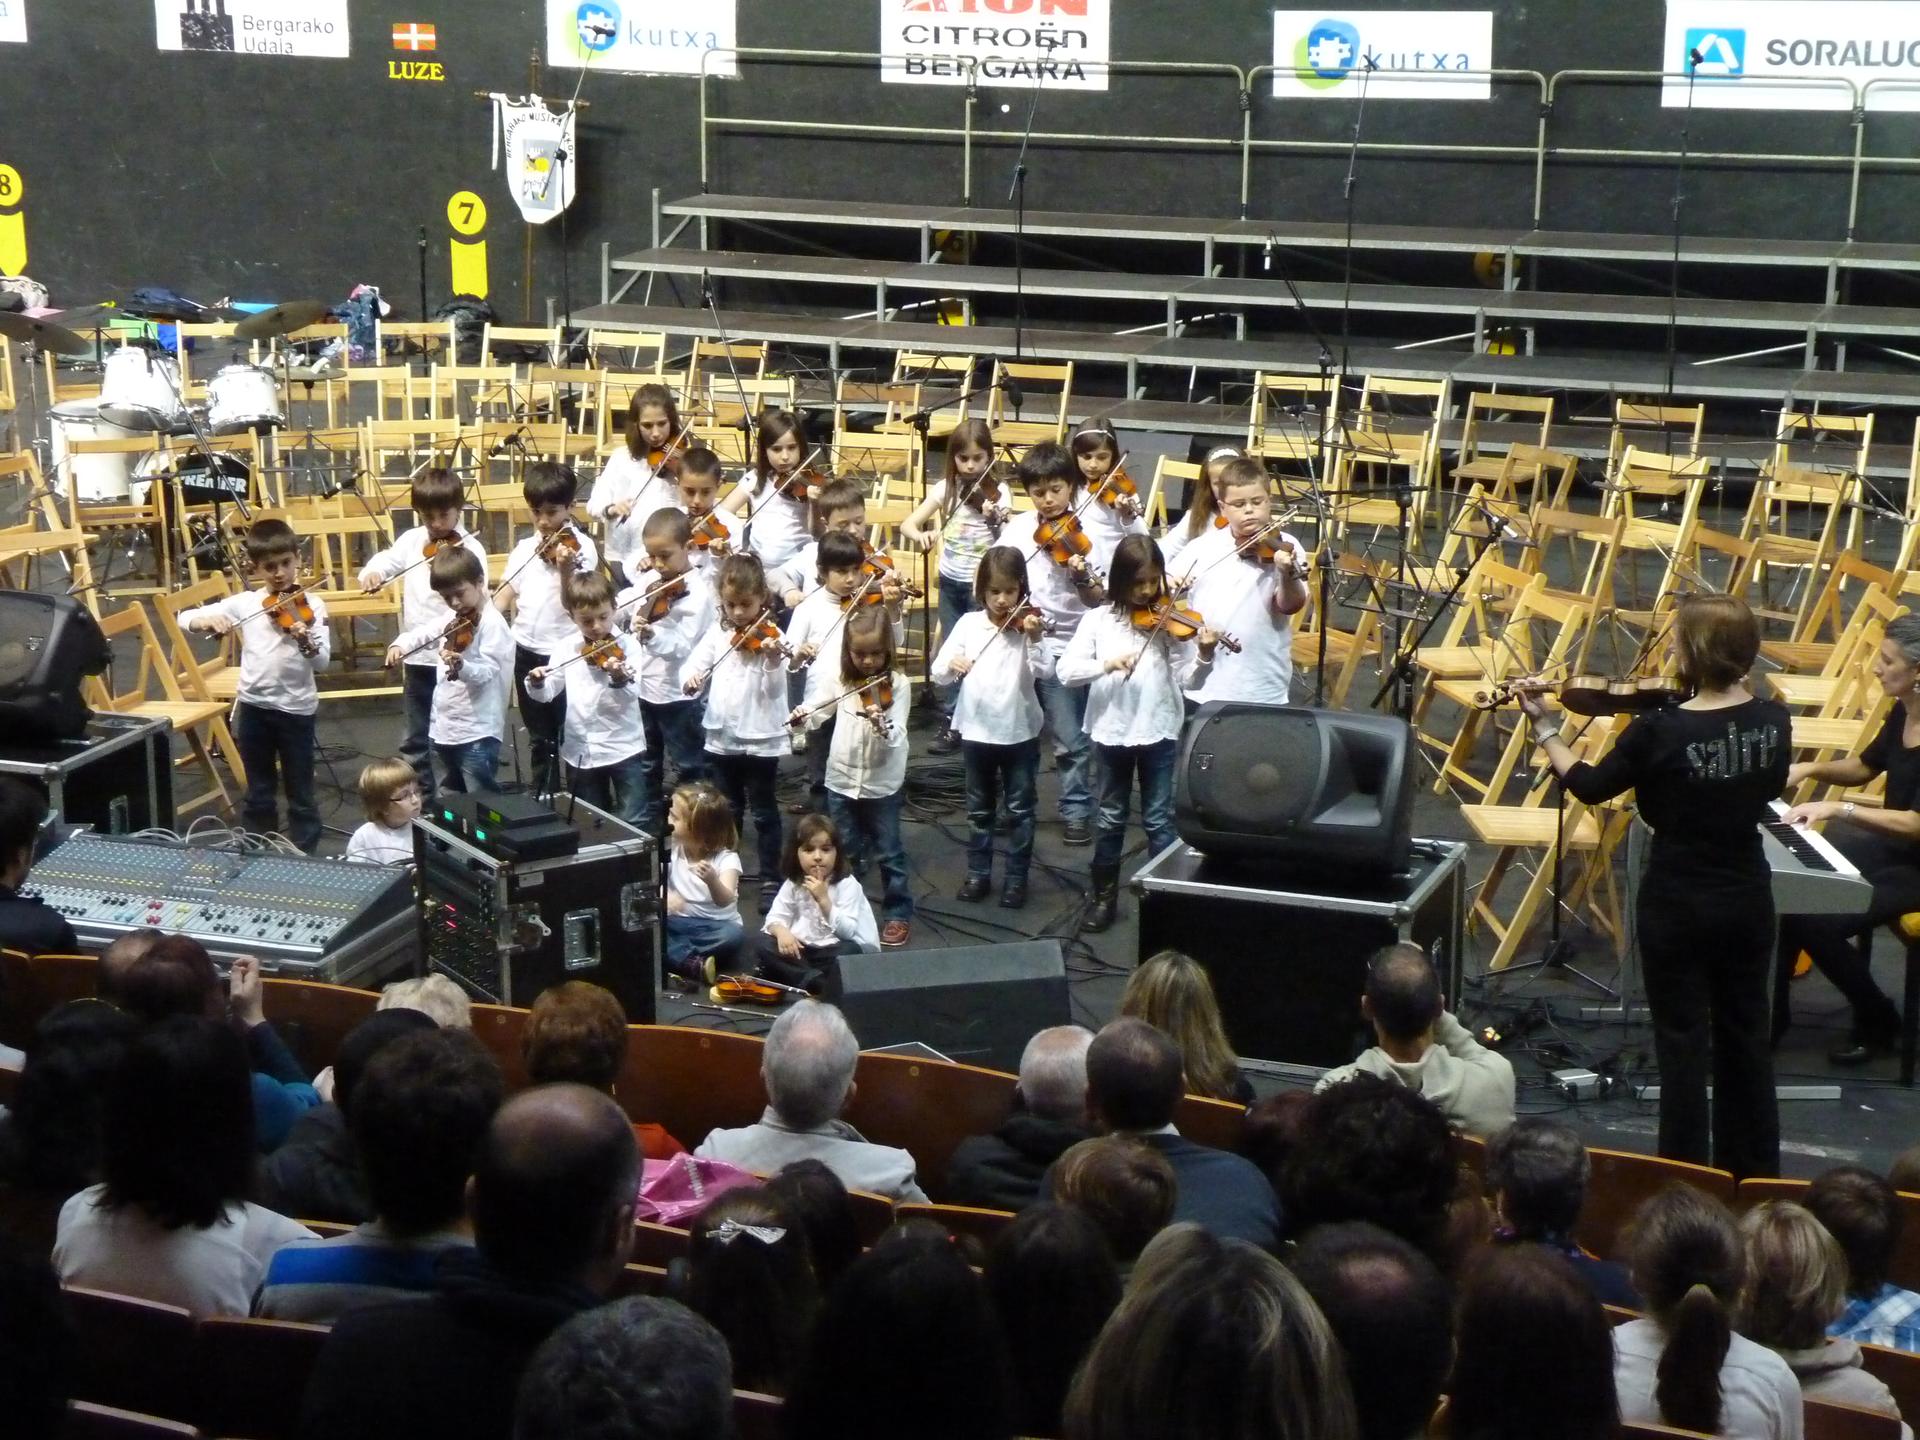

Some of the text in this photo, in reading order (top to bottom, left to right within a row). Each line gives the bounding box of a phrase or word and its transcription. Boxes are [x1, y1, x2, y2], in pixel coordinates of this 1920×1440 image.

[242, 14, 334, 36] Bergarako
[629, 20, 718, 49] kutxa
[243, 37, 294, 54] Udala
[1363, 44, 1470, 71] kutxa
[388, 60, 445, 81] LUZE
[0, 174, 11, 196] 8
[458, 201, 475, 225] 7
